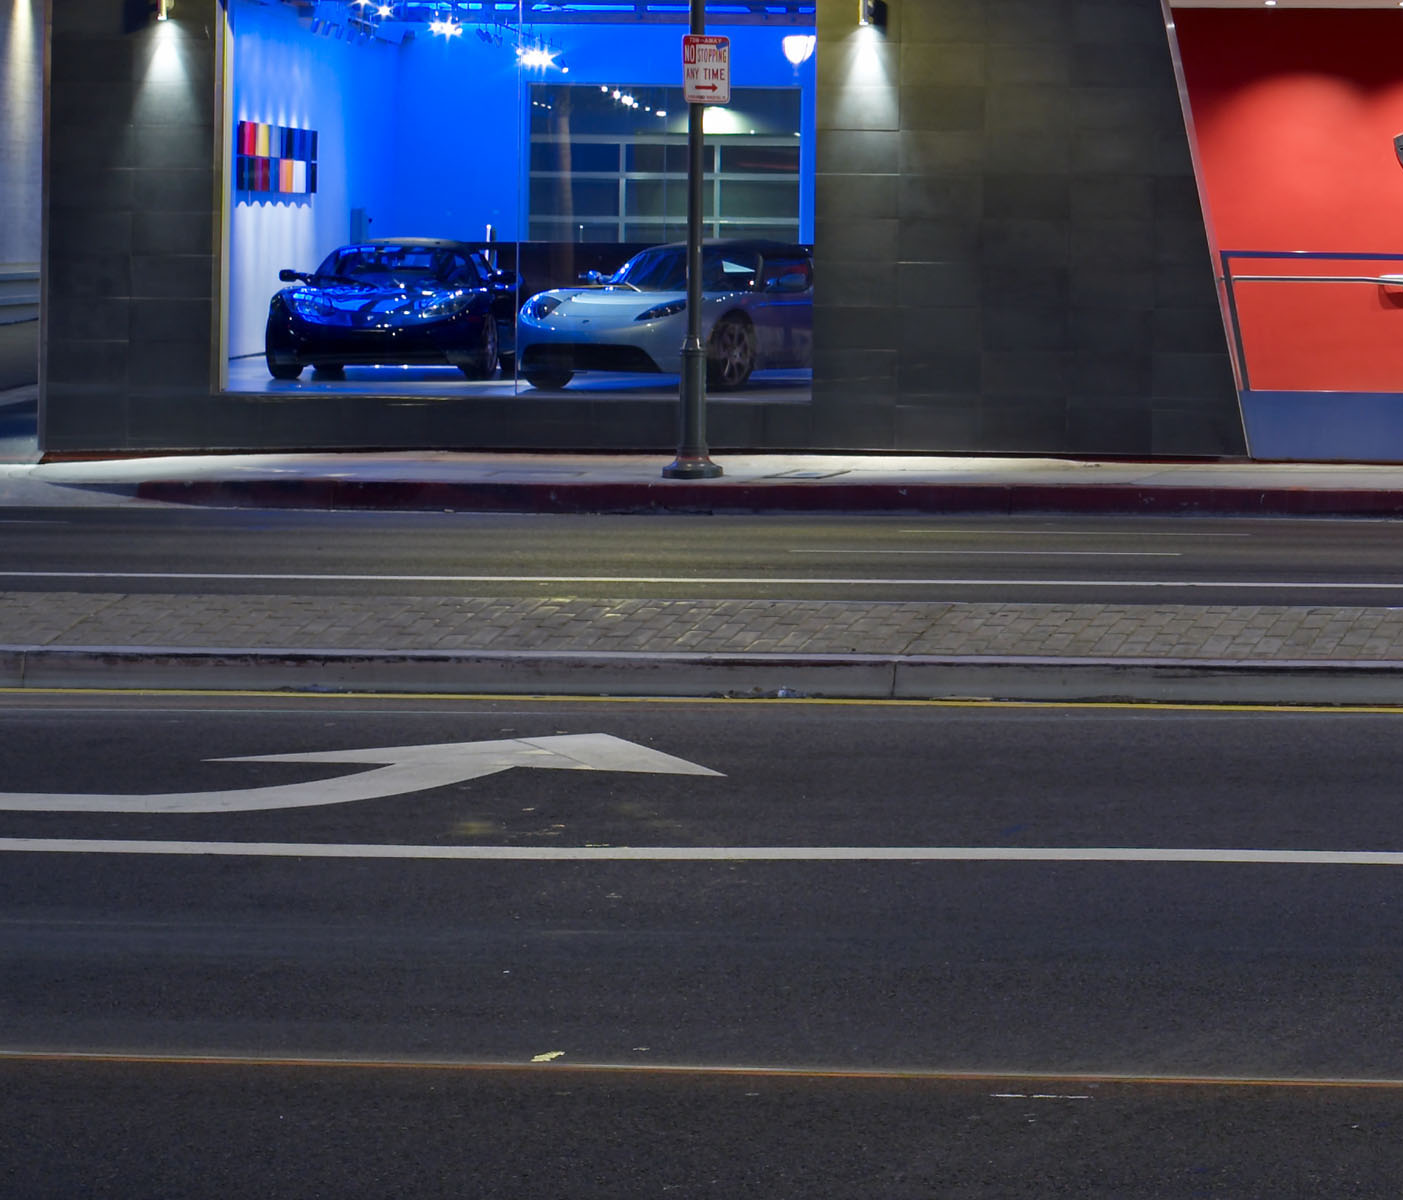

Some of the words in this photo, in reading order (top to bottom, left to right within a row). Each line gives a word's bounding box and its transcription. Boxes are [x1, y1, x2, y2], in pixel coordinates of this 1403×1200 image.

[685, 44, 696, 63] NO
[697, 46, 727, 64] STOPPING
[686, 67, 700, 81] ANY
[704, 68, 726, 81] TIME
